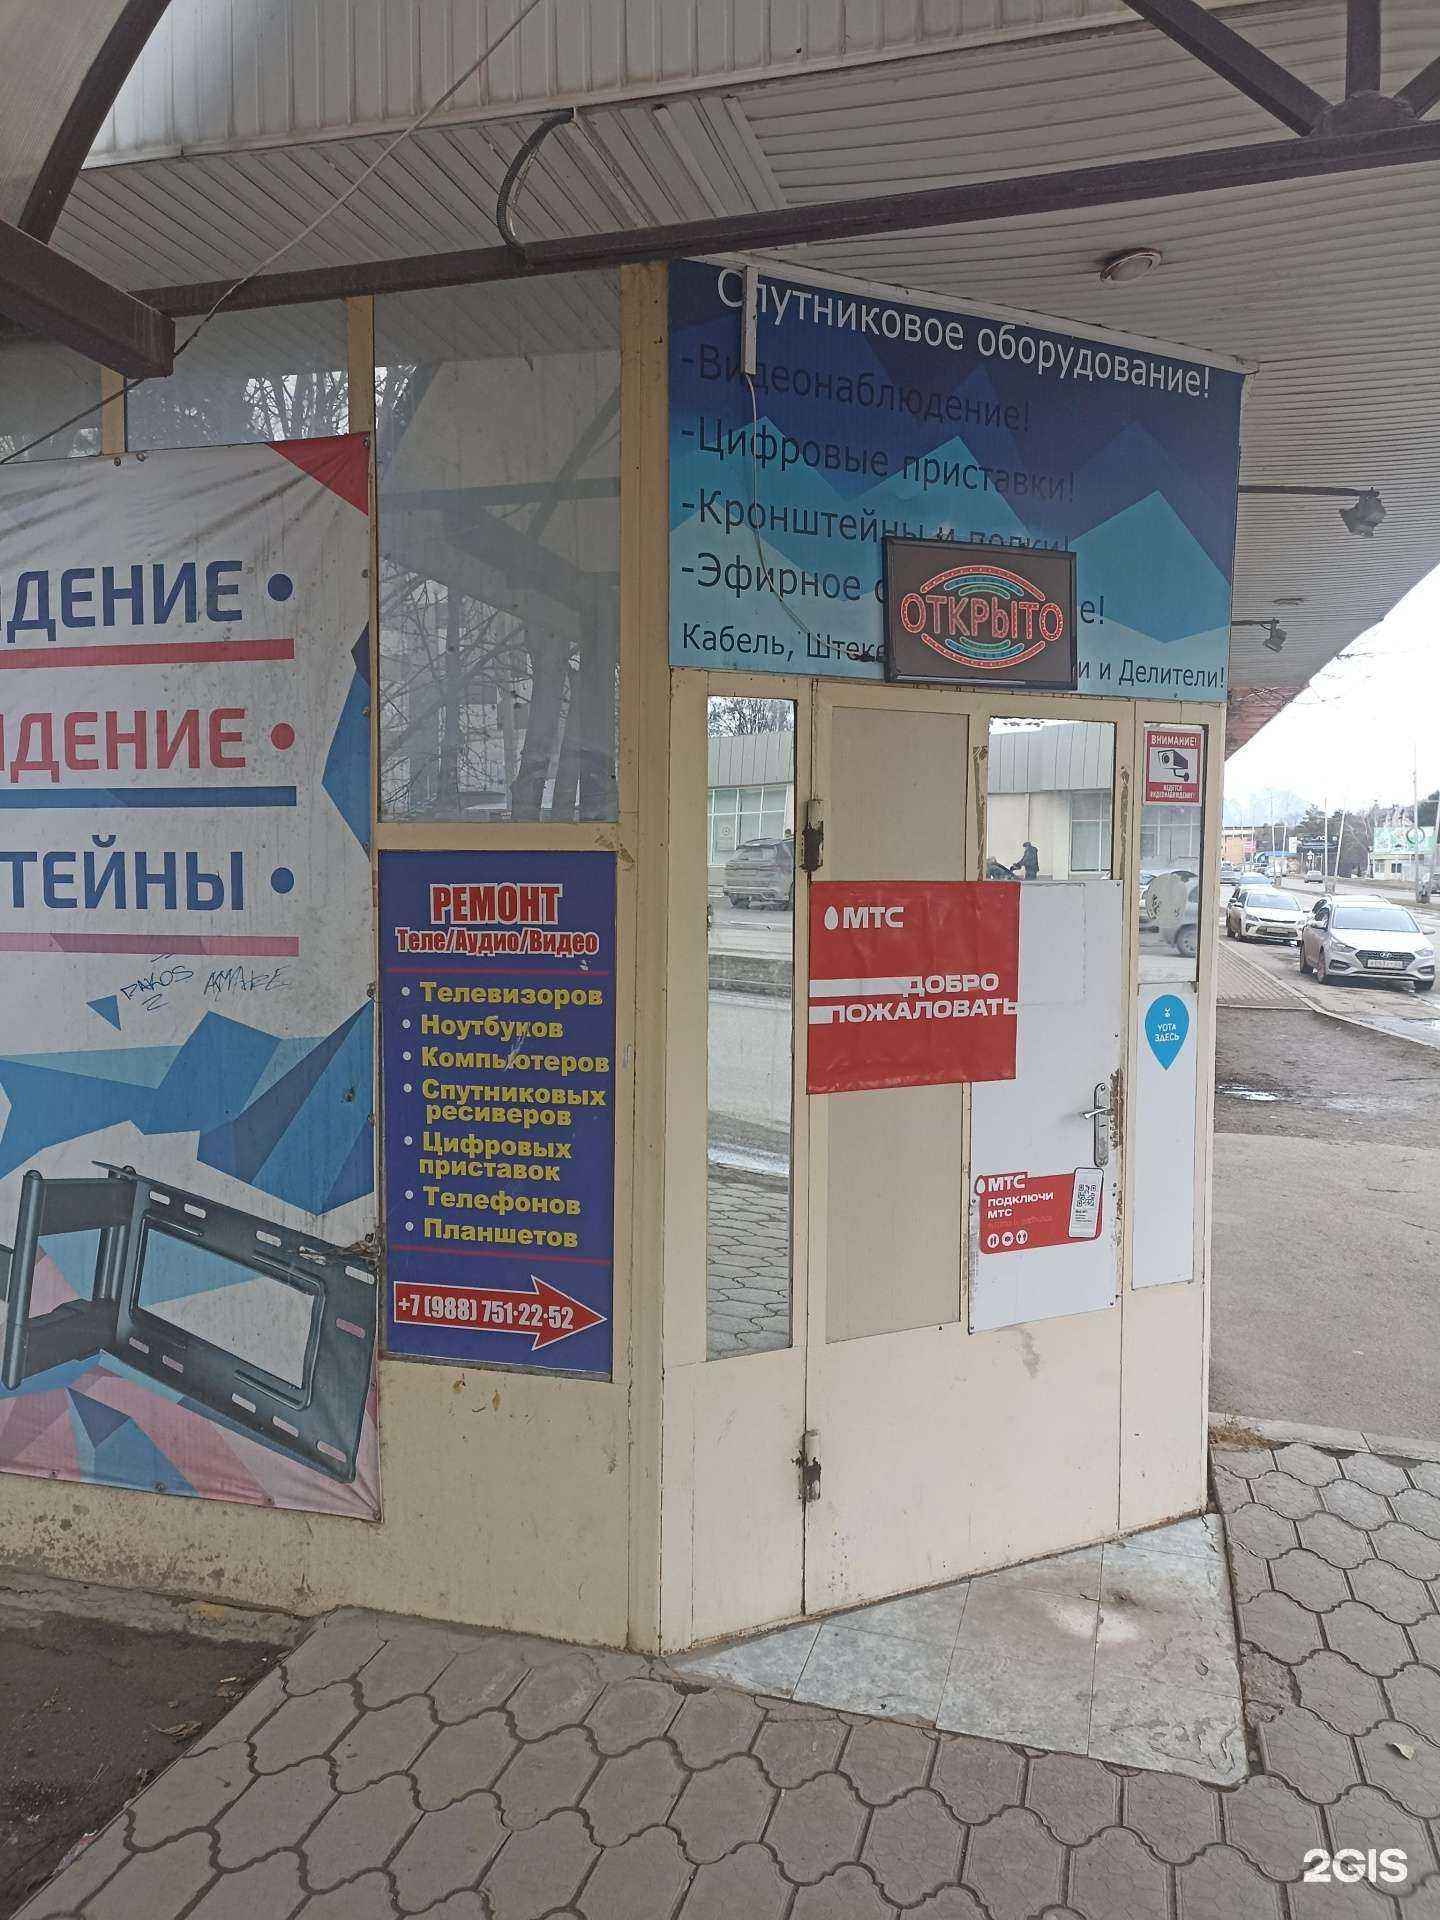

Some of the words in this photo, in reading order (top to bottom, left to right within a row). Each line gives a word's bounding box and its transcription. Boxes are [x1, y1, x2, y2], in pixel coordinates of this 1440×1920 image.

[717, 268, 964, 351] Спутниковое
[977, 324, 1210, 398] оборудование!
[903, 455, 1074, 502] приставки!
[0, 560, 244, 643] ДЕНИЕ
[900, 592, 1065, 642] ОТКРЫТО
[682, 622, 794, 662] Кабель,
[1099, 661, 1111, 680] и
[1118, 658, 1225, 689] Делители!
[1151, 734, 1197, 747] ВНИМАНИЕ!
[430, 882, 563, 925] РЕМОНТ
[842, 905, 904, 929] МТС
[395, 926, 600, 958] Теле/Аудио/Видео
[419, 981, 603, 1010] Телевизоров
[902, 973, 999, 998] ДОБРО
[831, 997, 1020, 1024] ПОЖАЛОВАТЬ
[420, 1014, 564, 1042] Ноутбуков
[1154, 1032, 1180, 1042] ЗДЕСЬ
[420, 1046, 610, 1077] Компьютеров
[421, 1078, 607, 1106] Спутниковых
[426, 1104, 572, 1129] ресиверов
[423, 1131, 572, 1159] Цифровых
[419, 1158, 561, 1182] приставок
[988, 1174, 1026, 1191] МТС
[423, 1185, 581, 1216] Телефонов
[987, 1191, 1054, 1208] ПОДКЛЮЧИ
[987, 1208, 1013, 1219] МТС
[423, 1217, 579, 1249] Планшетов
[398, 1294, 420, 1317] +7
